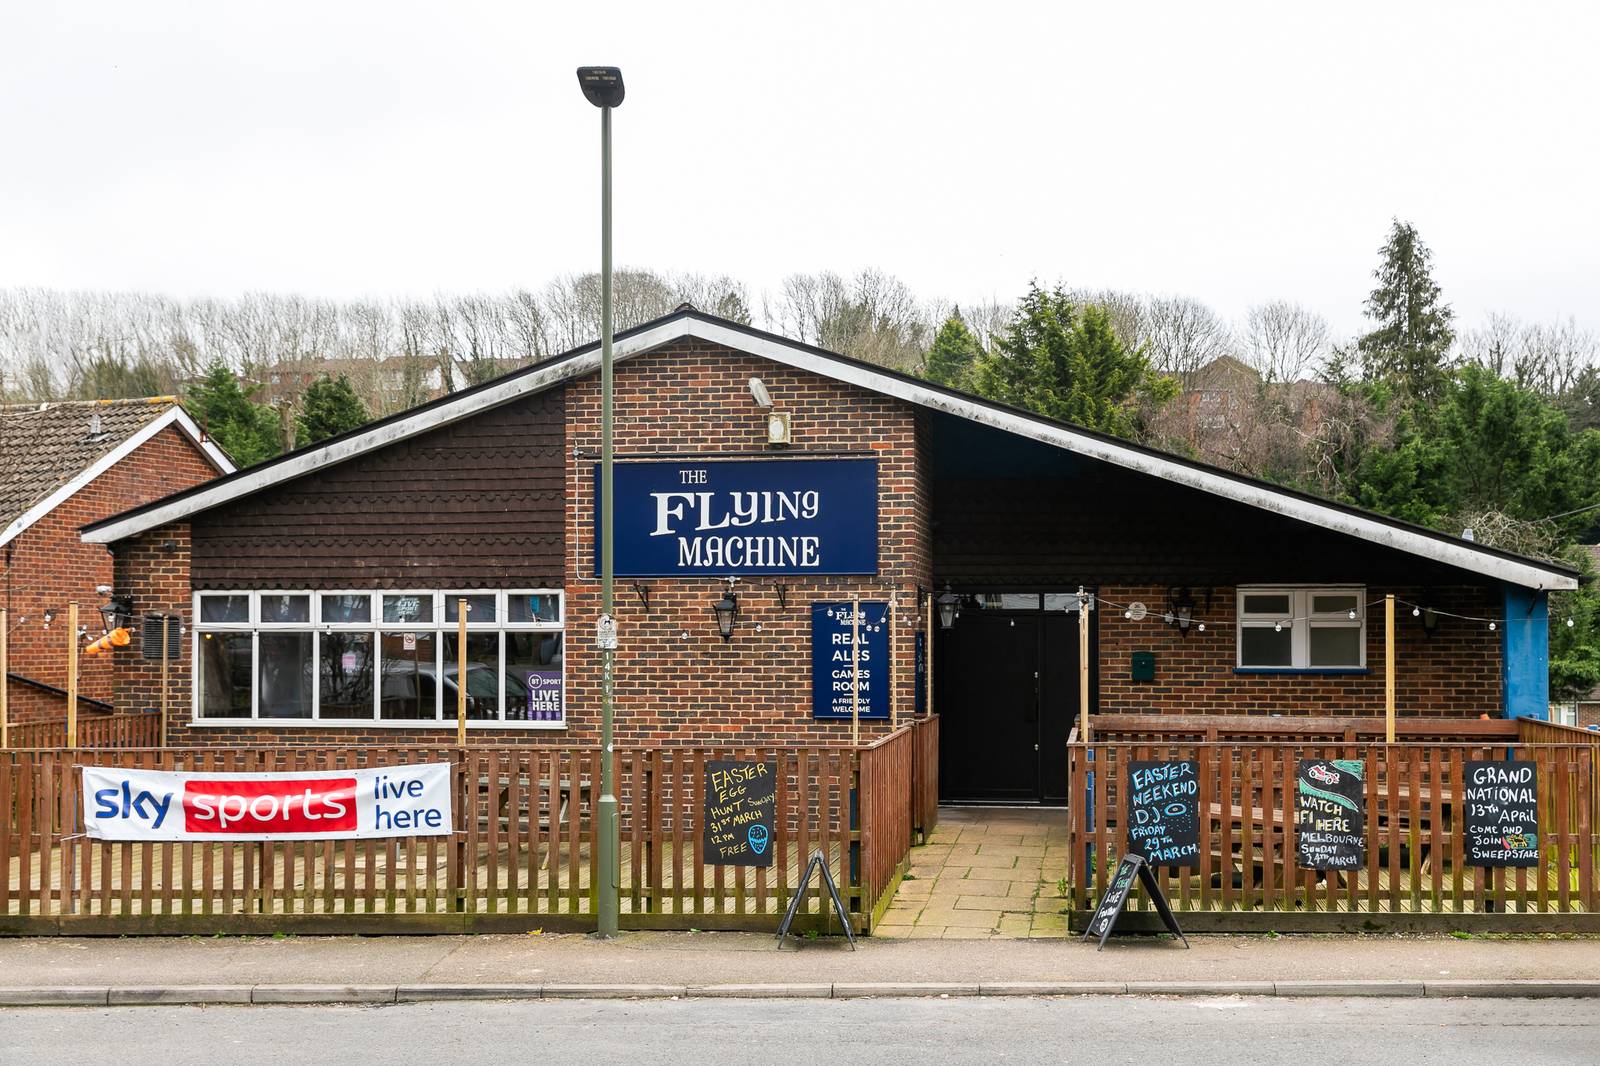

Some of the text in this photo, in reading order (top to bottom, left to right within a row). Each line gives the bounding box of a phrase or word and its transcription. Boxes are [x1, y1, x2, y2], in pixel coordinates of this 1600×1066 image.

[679, 470, 707, 484] THE
[650, 490, 819, 537] FLYING
[678, 536, 820, 567] MACHINE
[832, 633, 869, 645] REAL
[832, 650, 870, 661] ALES
[532, 690, 560, 701] LIVE
[532, 701, 560, 711] HERE
[711, 763, 768, 792] EASTER
[1132, 762, 1194, 790] EASTER
[1473, 767, 1532, 785] GRAND
[374, 775, 425, 800] live
[720, 786, 747, 803] EGG
[1132, 780, 1197, 807] WEEKEND
[95, 780, 347, 830] sky sports
[710, 799, 745, 819] HUNT
[1300, 796, 1343, 816] WATCH
[374, 804, 442, 830] here
[733, 810, 763, 827] MARCH
[1135, 806, 1161, 824] DJ
[1131, 825, 1166, 840] FRIDAY
[1315, 817, 1351, 832] HERE
[1469, 825, 1522, 834] COME AND
[711, 833, 735, 844] 12 PM
[1301, 832, 1364, 847] MELBOURNE
[719, 842, 747, 859] FREE
[1149, 843, 1197, 862] MARCH
[1472, 847, 1539, 861] SWEEPSTAKE
[1327, 855, 1357, 867] MARCH
